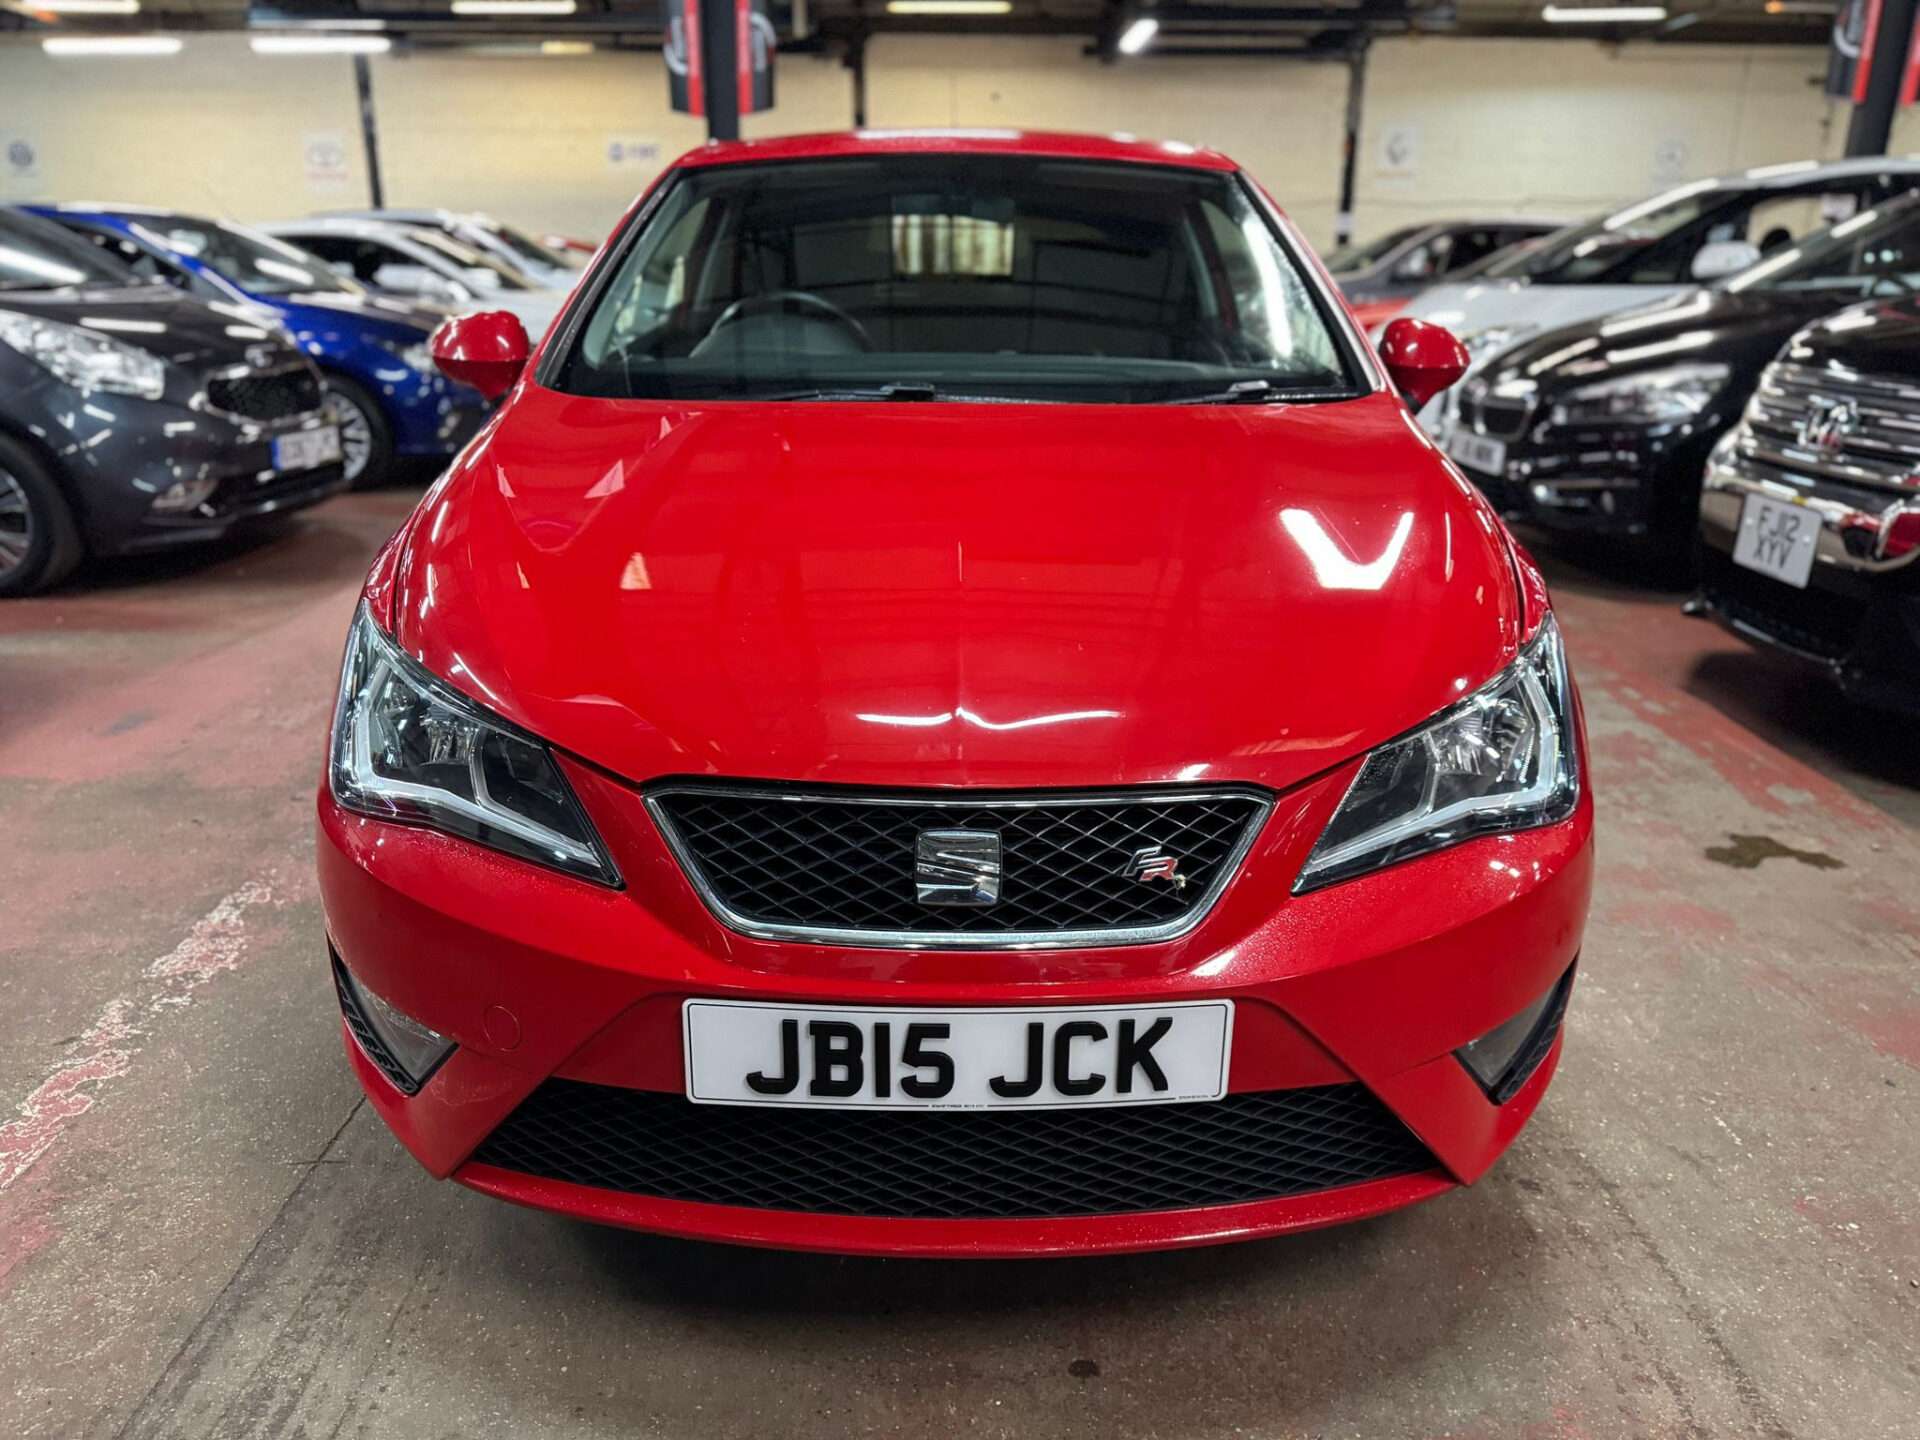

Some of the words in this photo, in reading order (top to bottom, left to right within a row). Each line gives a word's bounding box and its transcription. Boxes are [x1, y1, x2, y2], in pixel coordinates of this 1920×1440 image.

[1758, 505, 1801, 543] FJ12
[1122, 846, 1178, 882] FR
[746, 1018, 955, 1099] JB15
[989, 1016, 1173, 1097] JCK
